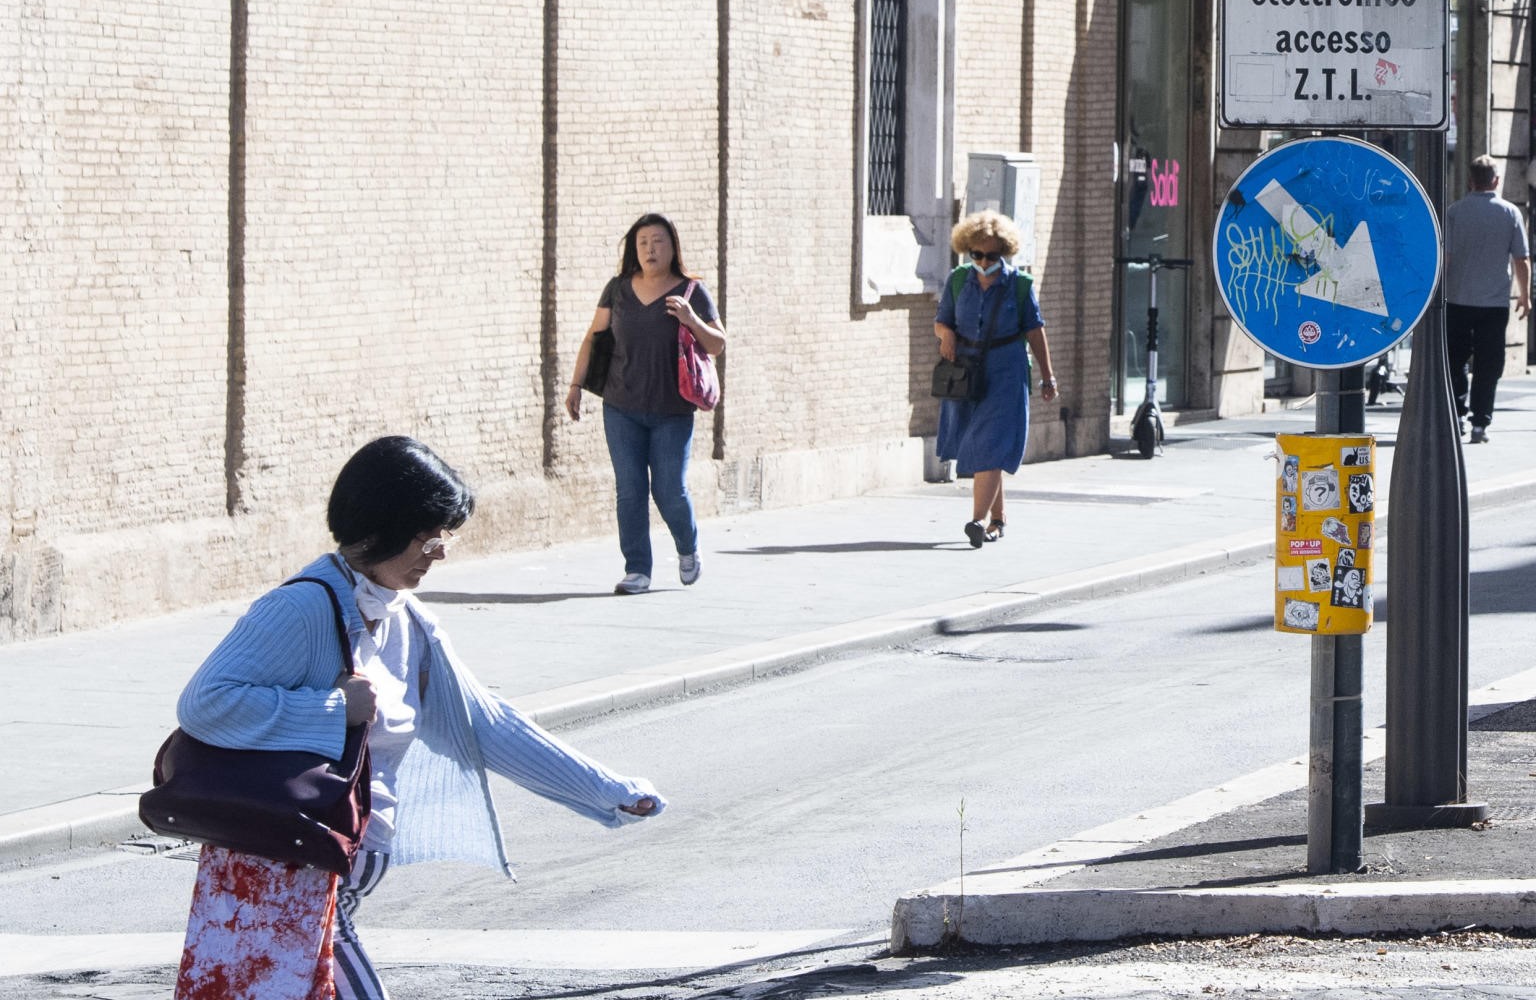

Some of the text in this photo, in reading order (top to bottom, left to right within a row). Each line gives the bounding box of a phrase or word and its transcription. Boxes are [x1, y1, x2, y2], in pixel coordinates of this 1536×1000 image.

[1276, 30, 1391, 54] accesso
[1294, 68, 1373, 101] Z.T.L.
[1150, 158, 1180, 207] Saldi
